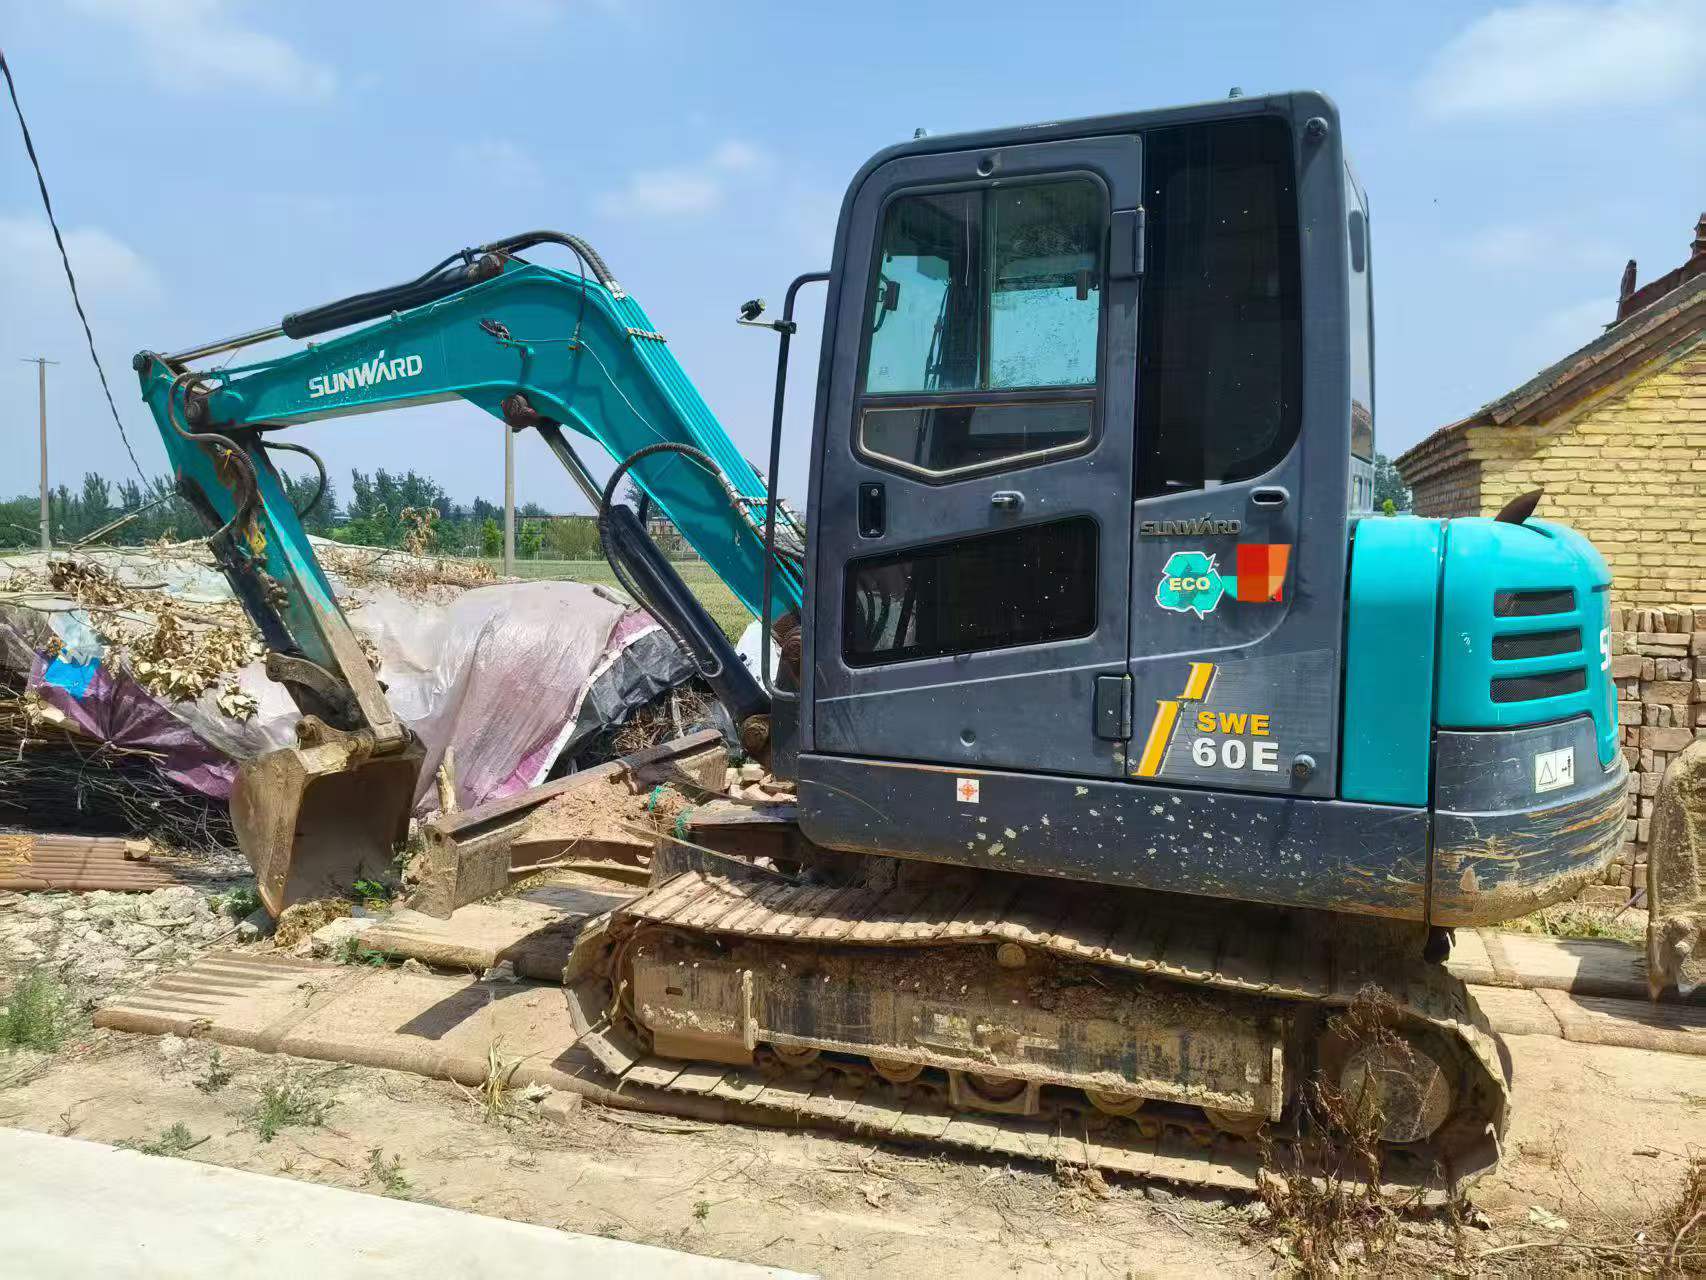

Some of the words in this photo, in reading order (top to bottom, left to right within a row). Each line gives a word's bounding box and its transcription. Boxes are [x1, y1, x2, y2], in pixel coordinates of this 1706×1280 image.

[309, 350, 423, 398] SUNWARD
[1140, 513, 1242, 536] SUNWARD
[1169, 577, 1210, 591] ECO
[1197, 711, 1271, 736] SWE
[1192, 738, 1280, 773] 60E
